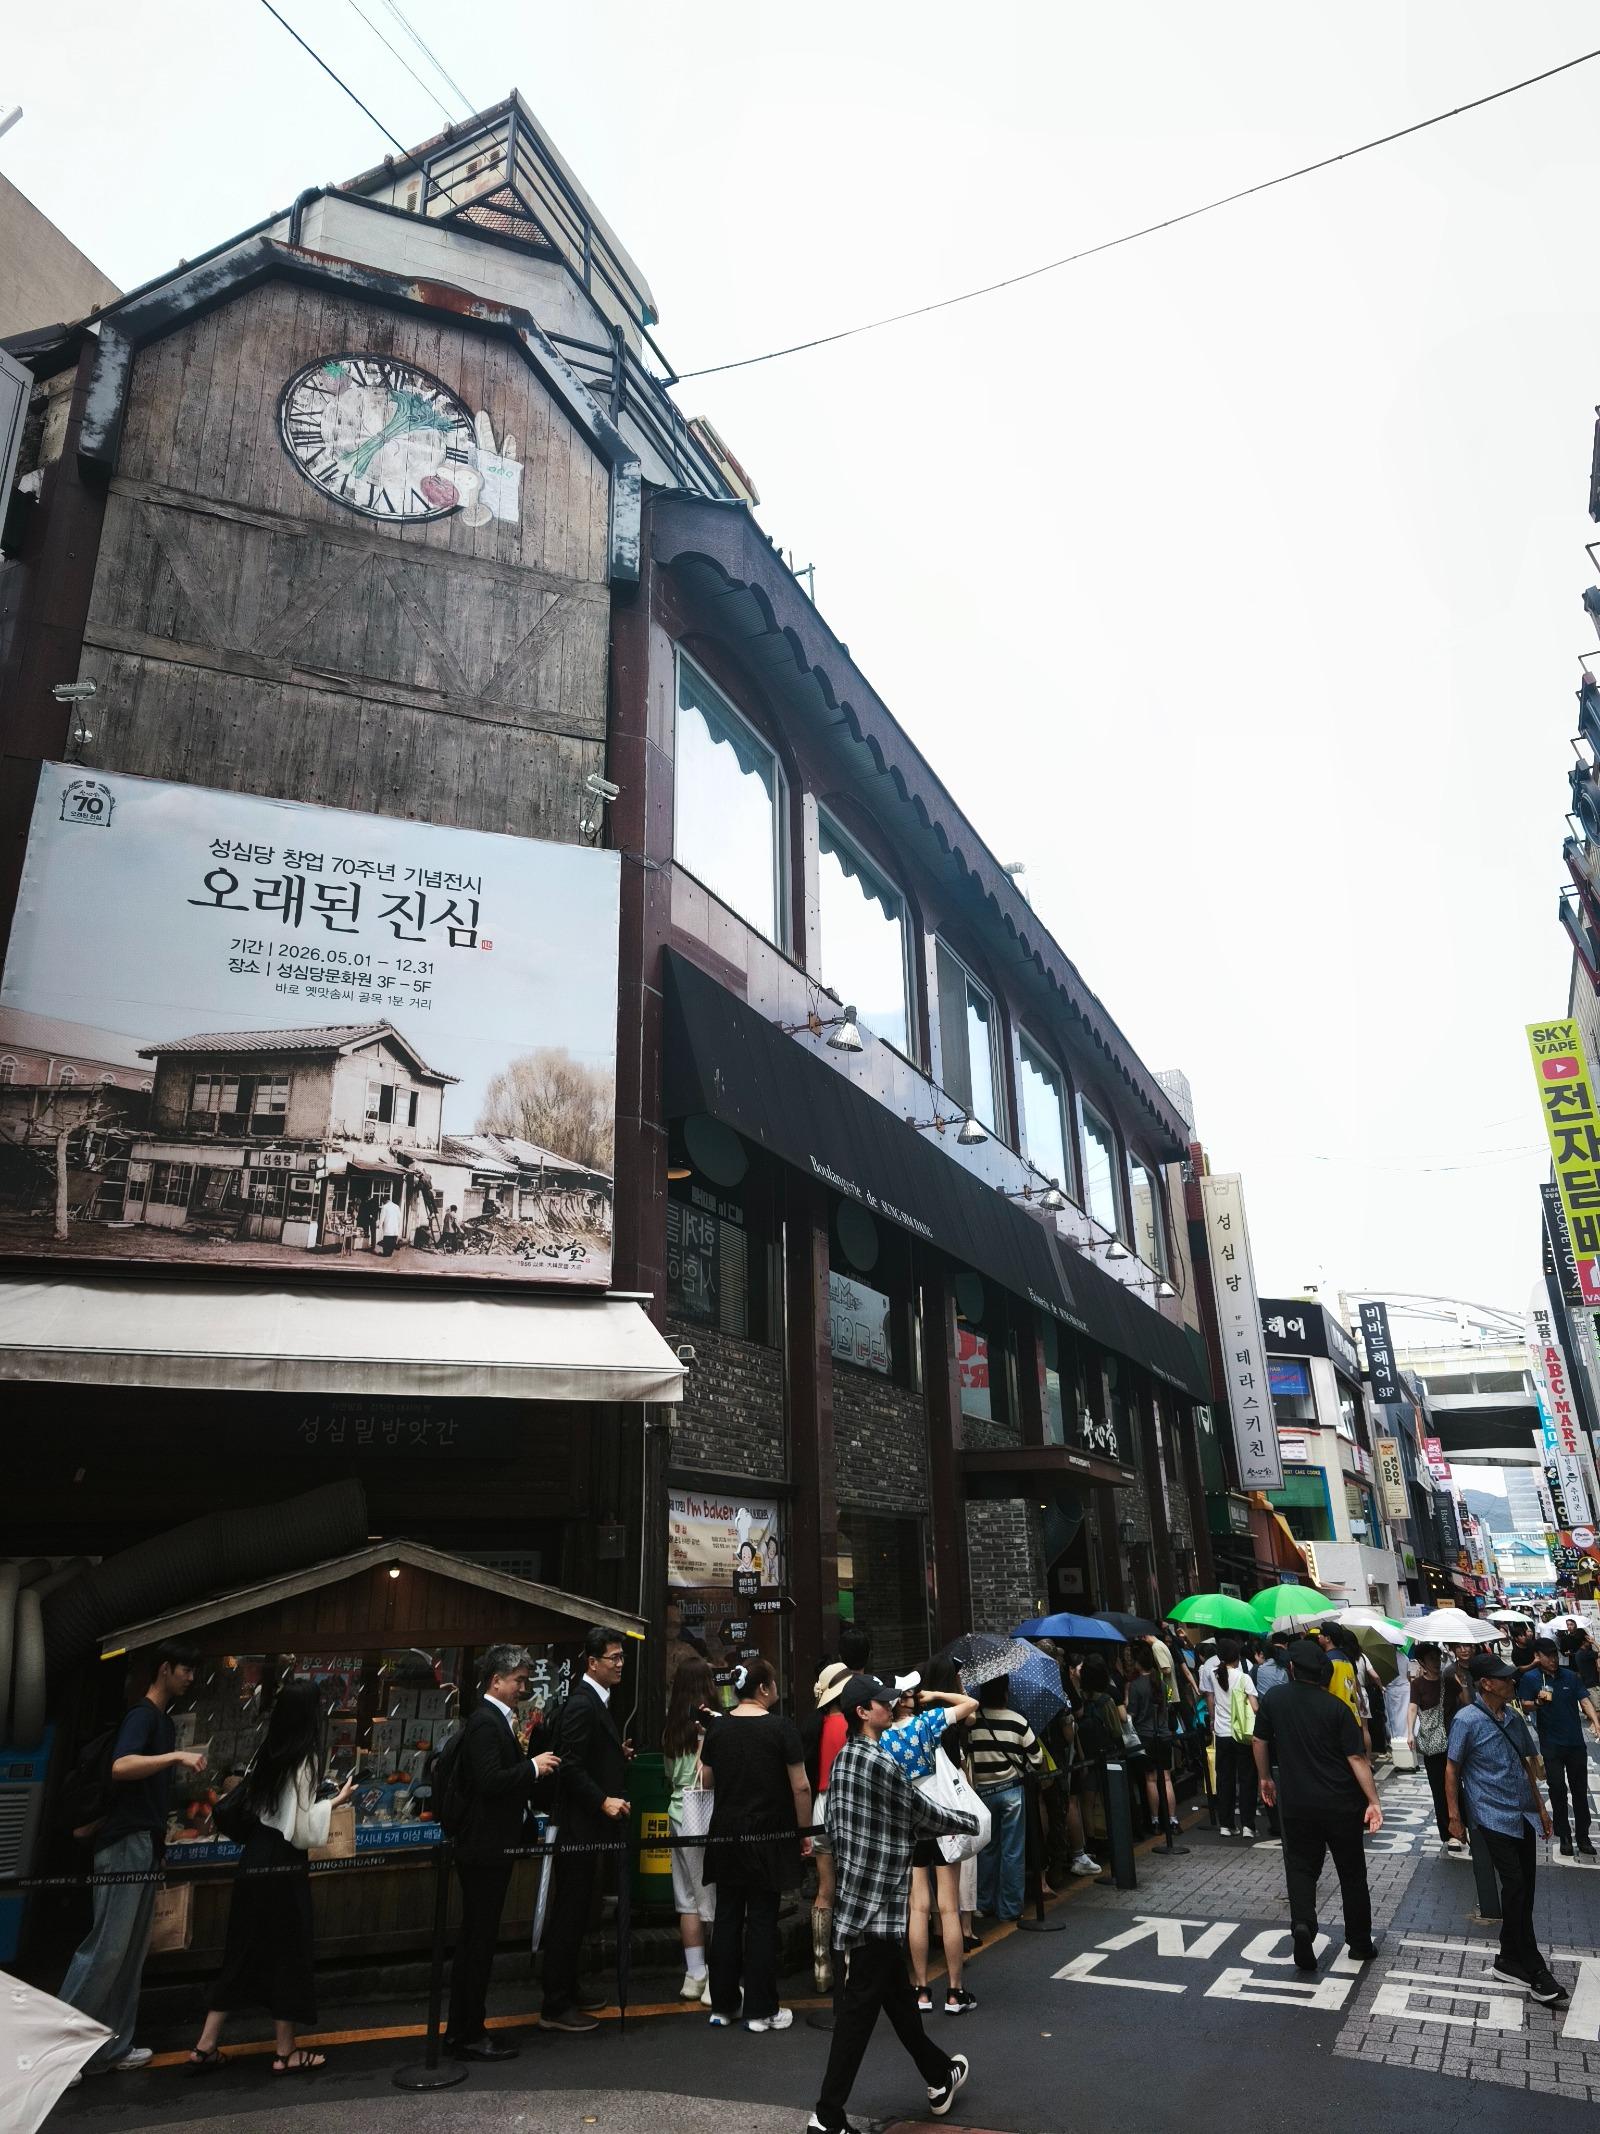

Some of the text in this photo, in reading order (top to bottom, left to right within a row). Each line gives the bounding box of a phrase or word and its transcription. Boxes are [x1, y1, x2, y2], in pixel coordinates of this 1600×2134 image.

[72, 795, 104, 814] 70
[208, 838, 482, 895] 성심당 창업 70주년 기념전시
[186, 866, 480, 949] 오래된 진심
[230, 938, 264, 957] 기간
[278, 943, 371, 967] 2026.05.01
[395, 958, 434, 975] 12.31
[228, 957, 261, 974] 장소
[276, 963, 372, 988] 성심당문화원
[377, 976, 395, 989] 3F
[412, 979, 432, 993] 5F
[275, 983, 299, 995] 바로
[408, 997, 432, 1011] 거리
[1532, 1023, 1574, 1042] SKY
[1534, 1040, 1578, 1055] VAPE
[866, 1189, 878, 1208] de
[1216, 1212, 1241, 1292] 성심당
[1263, 1316, 1306, 1340] 헤어
[1364, 1305, 1391, 1382] 비바드헤어
[1236, 1348, 1266, 1458] 테라스키친
[1378, 1386, 1395, 1398] 3F
[297, 1416, 459, 1446] 성심밀방앗간
[1383, 1460, 1392, 1482] ODD
[686, 1496, 701, 1518] I'm
[704, 1500, 734, 1520] baker
[1554, 1548, 1579, 1561] 코인
[676, 1599, 707, 1615] Thanks
[709, 1601, 718, 1614] to
[528, 1658, 553, 1710] 포장
[384, 1831, 400, 1844] 5개
[402, 1830, 421, 1842] 이상
[423, 1828, 442, 1840] 배달
[560, 1842, 627, 1853] SUNGSIMDANG
[739, 1831, 796, 1843] SUNGSIMDANG
[310, 1857, 386, 1870] SUNGSIMDANG
[86, 1872, 166, 1884] SUNGSIMDANG
[1050, 1914, 1600, 2042] 진입금
